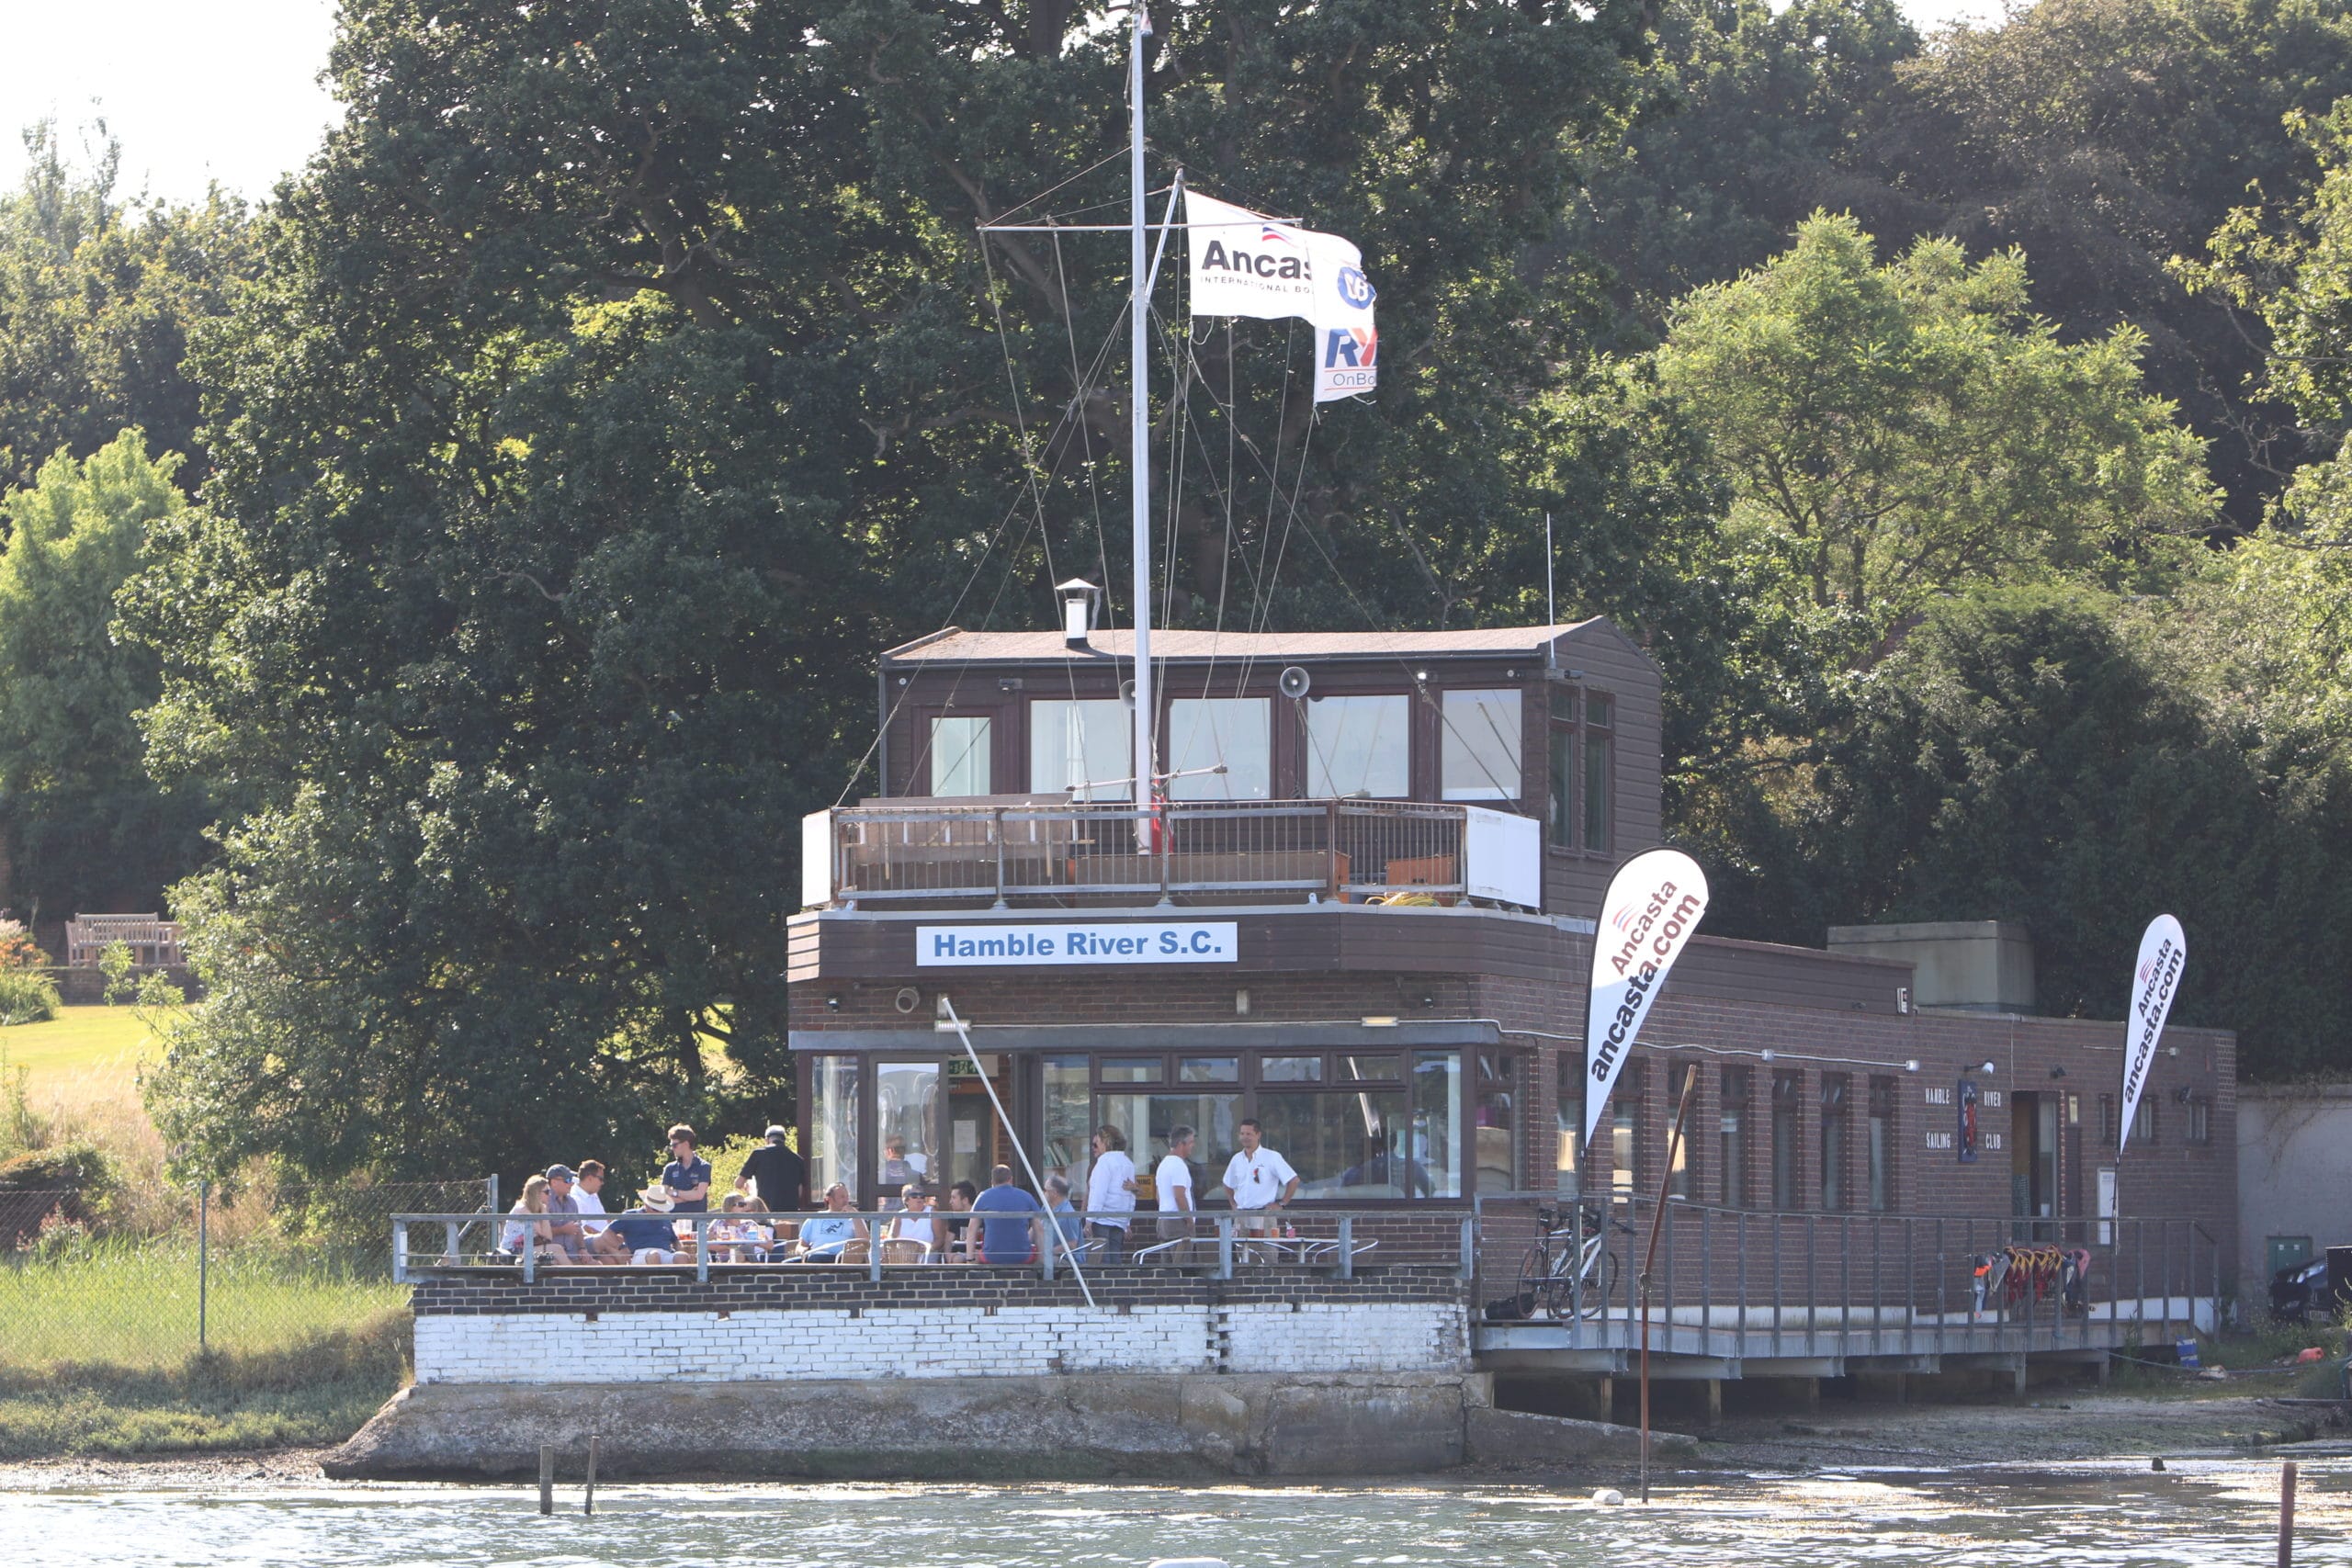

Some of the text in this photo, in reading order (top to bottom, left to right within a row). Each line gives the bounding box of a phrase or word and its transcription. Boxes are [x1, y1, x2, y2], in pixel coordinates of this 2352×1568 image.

[1200, 276, 1314, 295] INTERNATIONAL BO
[934, 931, 1222, 957] Hamble River S.C.
[1611, 881, 1678, 976] Ancasta
[1591, 893, 1701, 1082] ancasta.com
[2138, 938, 2172, 1018] Ancasta
[2124, 948, 2183, 1104] ancasta.com
[1925, 1088, 2001, 1108] HAMBLE RIVER
[1926, 1132, 2001, 1150] SAILING CLUB
